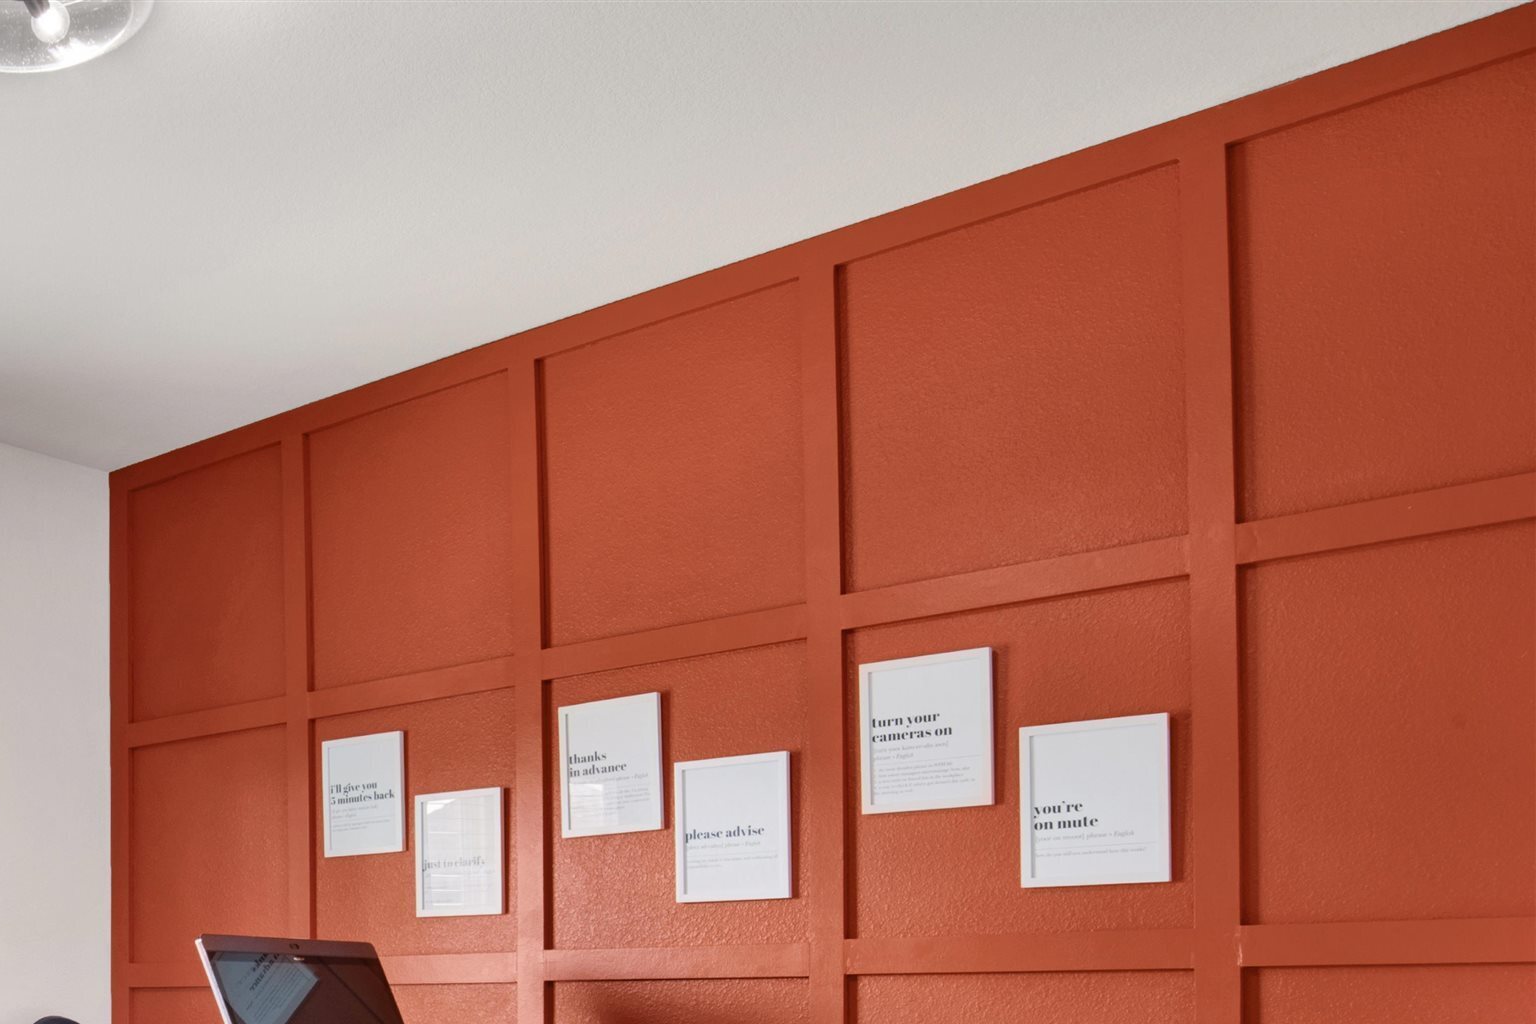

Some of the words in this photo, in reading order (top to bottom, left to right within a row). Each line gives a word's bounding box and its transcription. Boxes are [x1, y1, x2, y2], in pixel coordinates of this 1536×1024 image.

[872, 718, 903, 728] turn
[905, 713, 940, 728] your
[872, 729, 932, 743] cameras
[934, 727, 952, 736] on
[569, 751, 607, 764] thanks
[569, 768, 580, 777] in
[582, 764, 627, 776] advance
[330, 797, 336, 805] 5
[337, 794, 372, 804] minutes
[373, 789, 395, 800] back
[343, 783, 360, 797] give
[362, 782, 378, 793] you
[1034, 821, 1053, 831] on
[1057, 817, 1098, 829] mute
[685, 829, 723, 844] please
[725, 825, 765, 838] advise
